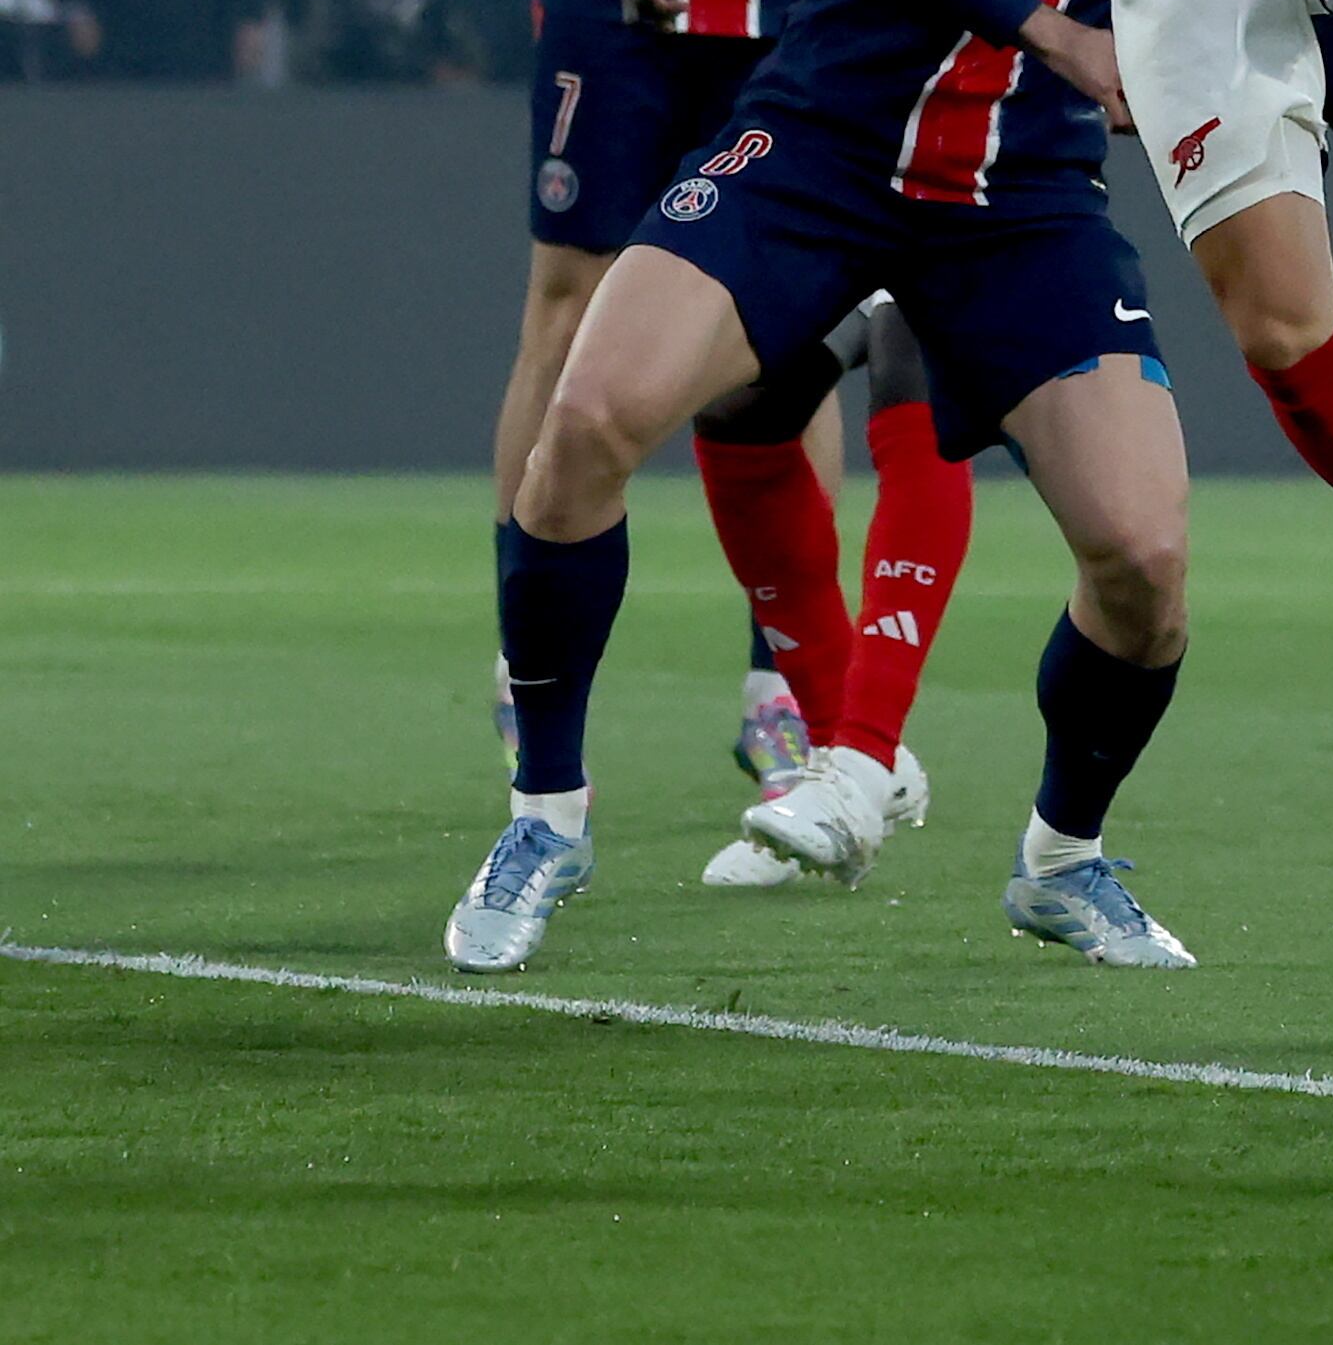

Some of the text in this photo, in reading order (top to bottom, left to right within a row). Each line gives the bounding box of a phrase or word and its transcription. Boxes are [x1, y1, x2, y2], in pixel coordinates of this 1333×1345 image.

[550, 70, 582, 156] 7
[699, 130, 773, 175] 8
[874, 559, 937, 585] AFC
